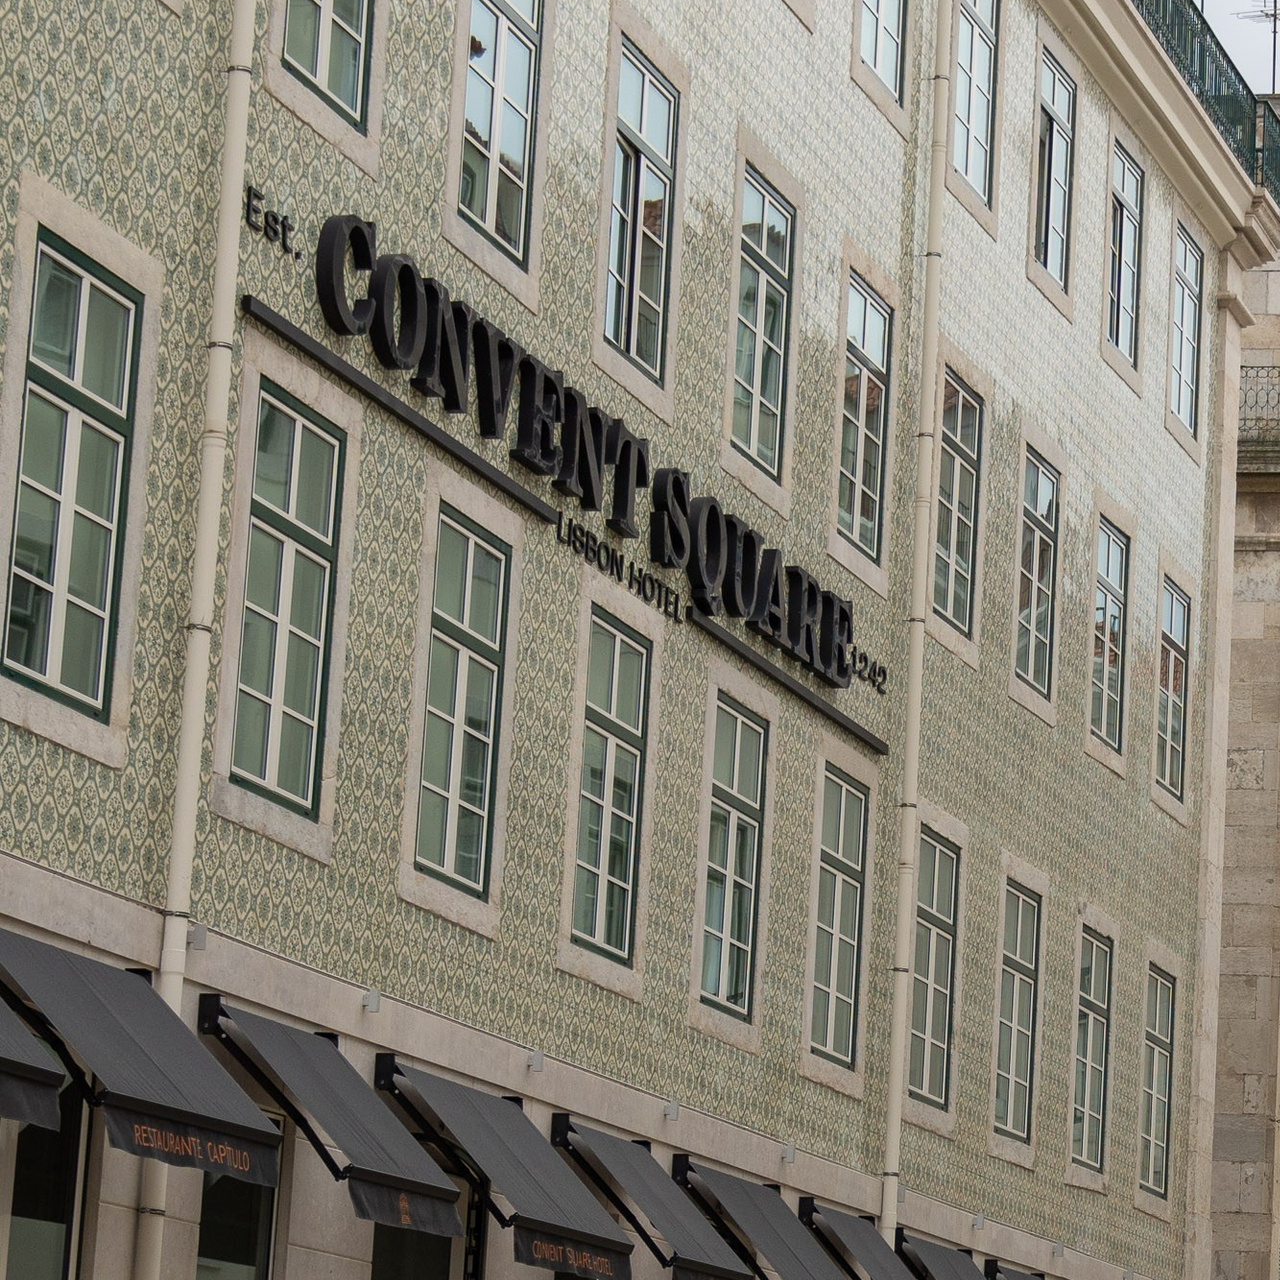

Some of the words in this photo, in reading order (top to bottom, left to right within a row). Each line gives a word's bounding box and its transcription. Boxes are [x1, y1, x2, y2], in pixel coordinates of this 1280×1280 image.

[246, 186, 302, 260] Est.
[317, 215, 649, 538] CONVENT
[650, 467, 853, 689] SQUARE
[557, 511, 624, 583] LISBON
[628, 561, 683, 624] HOTEL
[851, 645, 887, 695] 1242
[133, 1123, 203, 1159] RESTAURANTE
[532, 1240, 563, 1262] CONVENT
[566, 1247, 593, 1270] SQUARE
[593, 1256, 614, 1276] HOTEL
